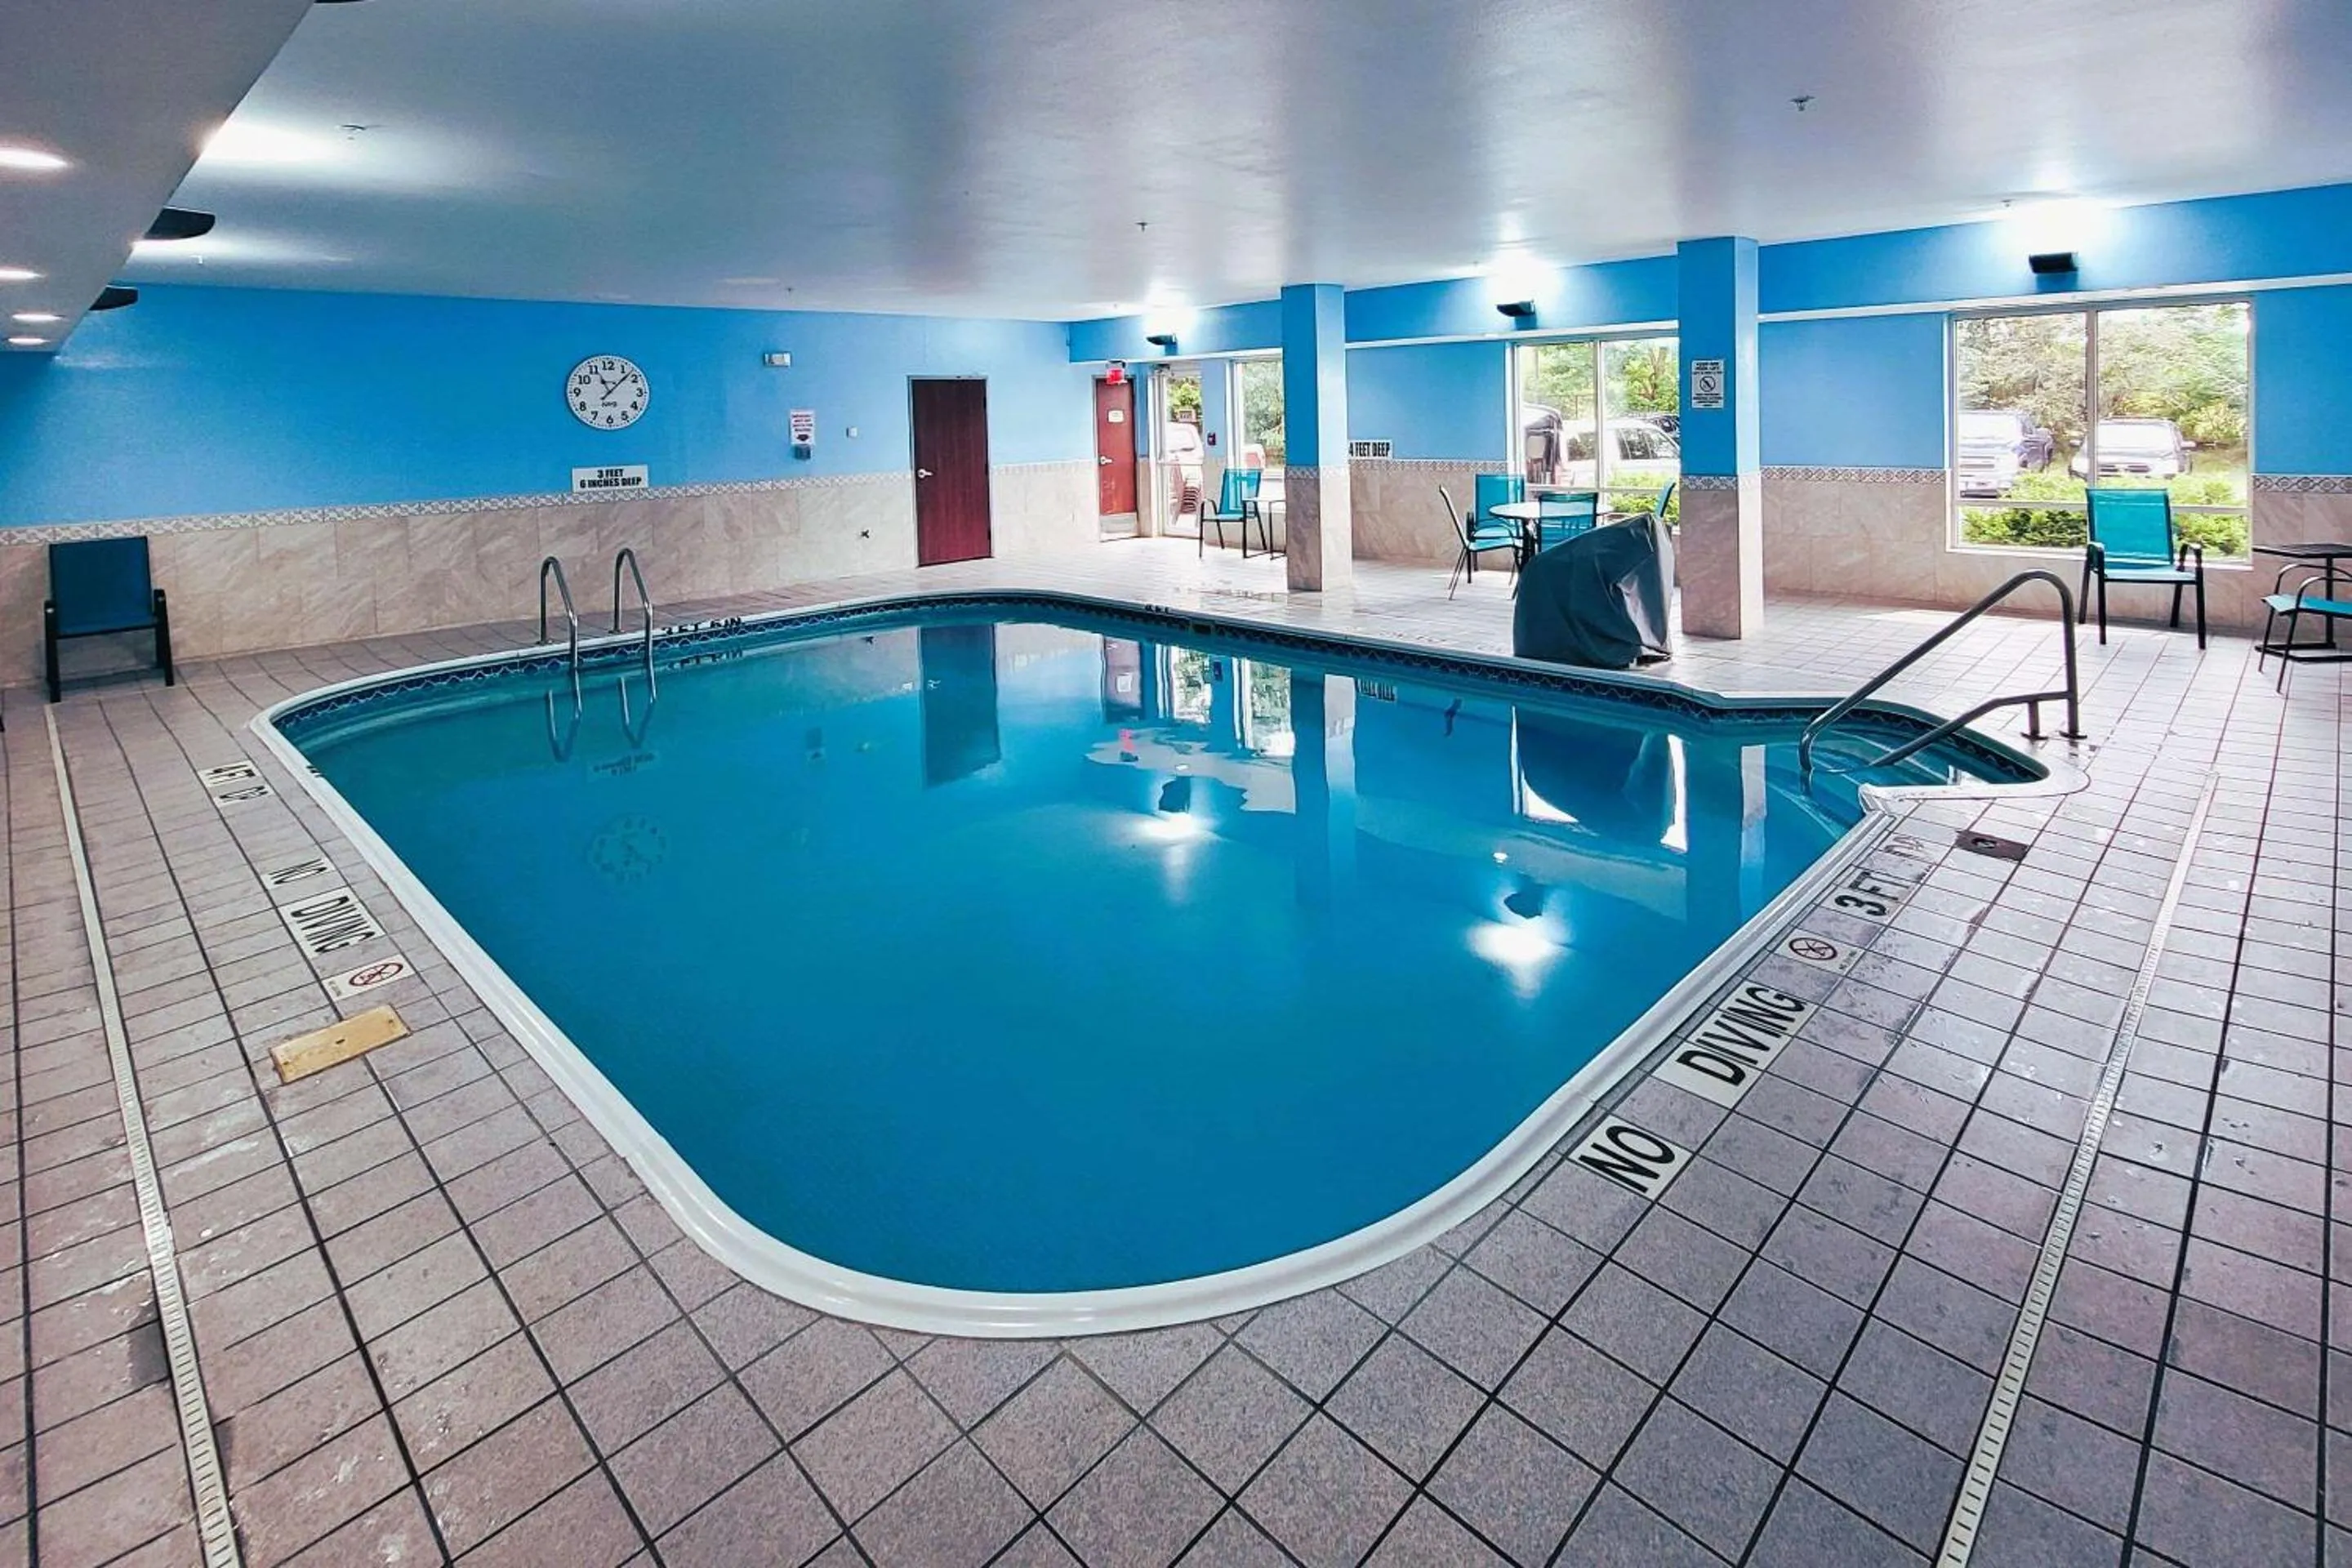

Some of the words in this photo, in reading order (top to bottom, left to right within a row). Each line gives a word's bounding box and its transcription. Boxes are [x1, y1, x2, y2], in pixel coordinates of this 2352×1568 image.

[589, 365, 599, 375] 11
[602, 360, 615, 371] 12
[621, 364, 626, 374] 1
[578, 375, 591, 385] 10
[631, 374, 639, 384] 2
[573, 387, 581, 397] 9
[636, 388, 644, 398] 3
[579, 401, 587, 412] 8
[630, 401, 639, 410] 4
[590, 411, 598, 421] 7
[606, 415, 614, 424] 6
[621, 411, 629, 421] 5
[1356, 442, 1370, 457] FEET
[1372, 442, 1390, 457] DEEP
[597, 470, 604, 479] 3
[605, 469, 623, 477] FEET
[580, 479, 586, 488] 6
[588, 478, 620, 488] INCHES
[621, 476, 642, 486] DEEP
[269, 858, 327, 885] NO
[291, 895, 376, 954] DIVING
[1578, 1125, 1675, 1194] NO
[1676, 987, 1808, 1087] DIVING
